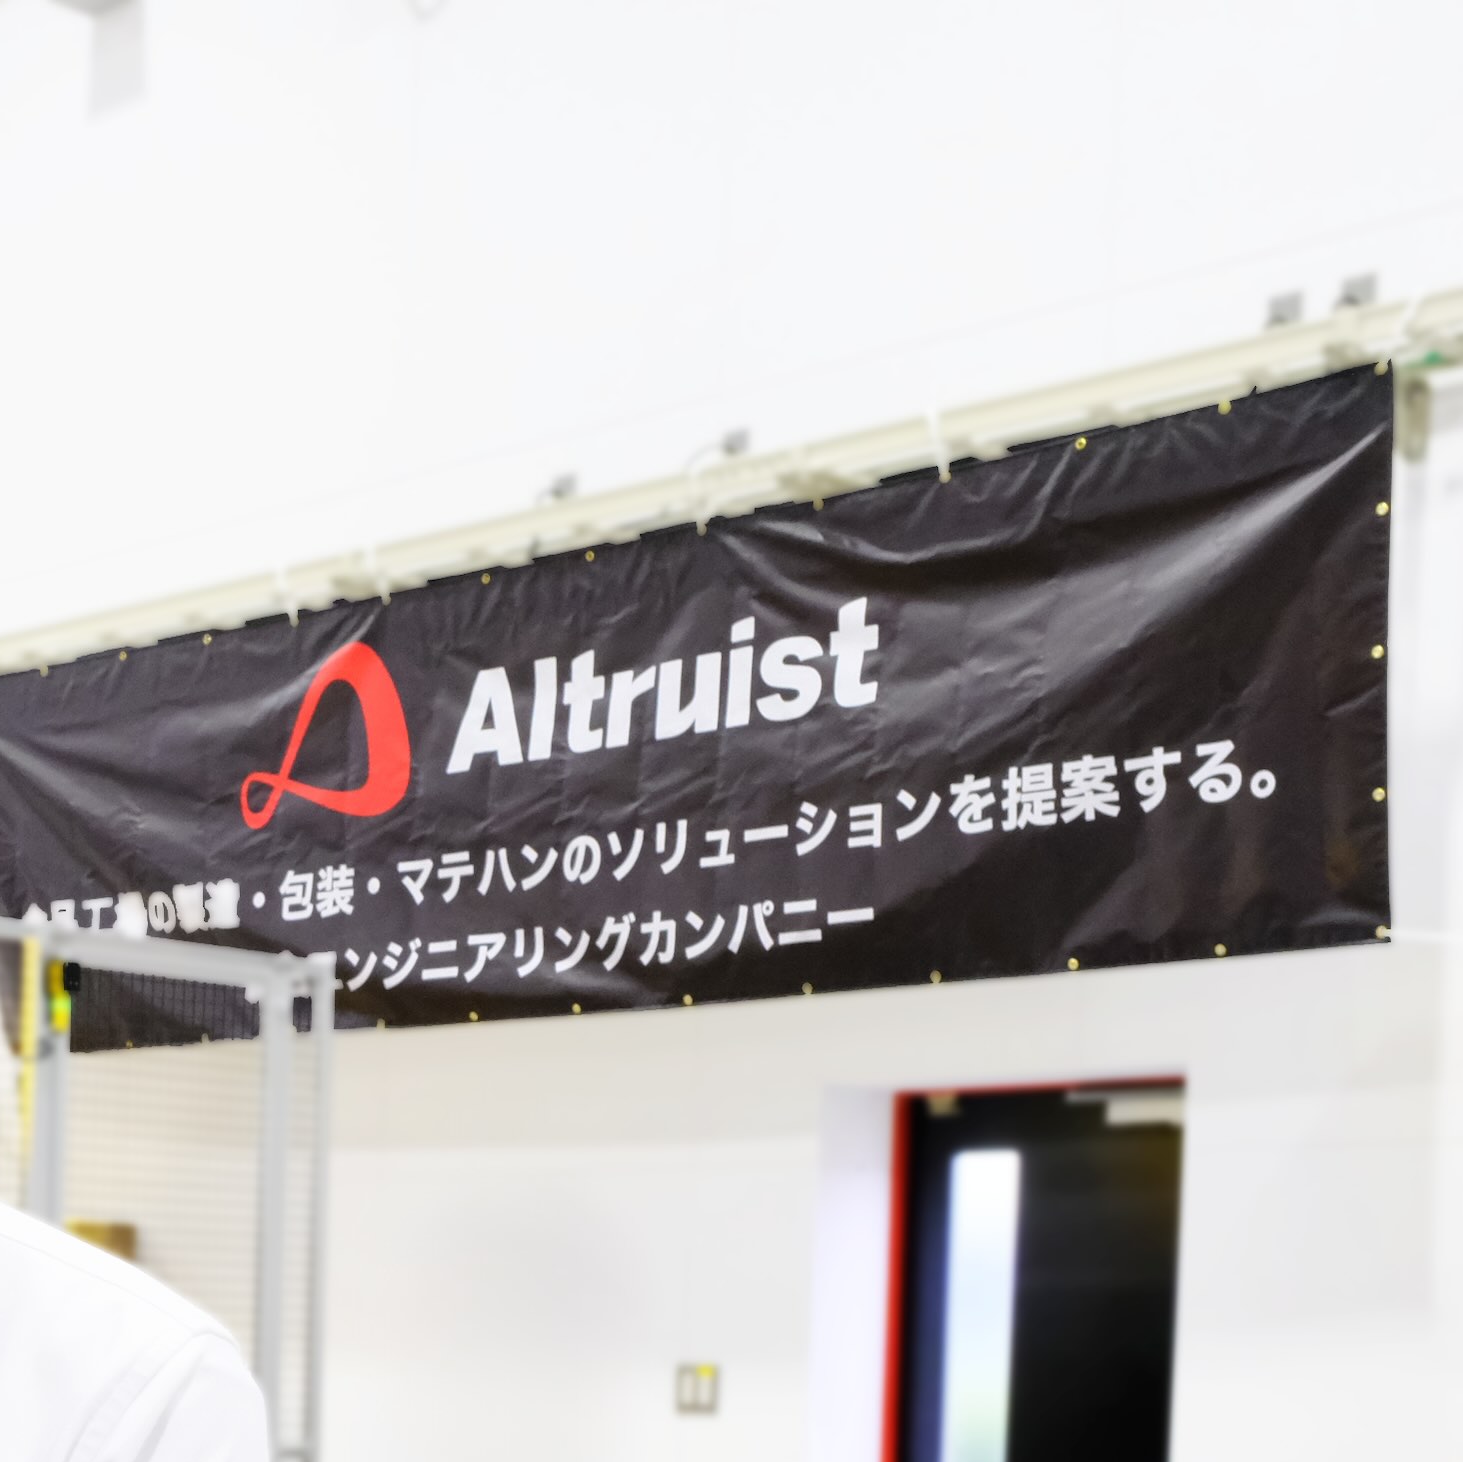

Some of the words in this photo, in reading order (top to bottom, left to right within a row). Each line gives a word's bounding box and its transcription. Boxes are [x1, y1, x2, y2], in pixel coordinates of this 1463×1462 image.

[445, 596, 880, 775] Altruist
[306, 898, 876, 993] ンジニアリングカンパニー
